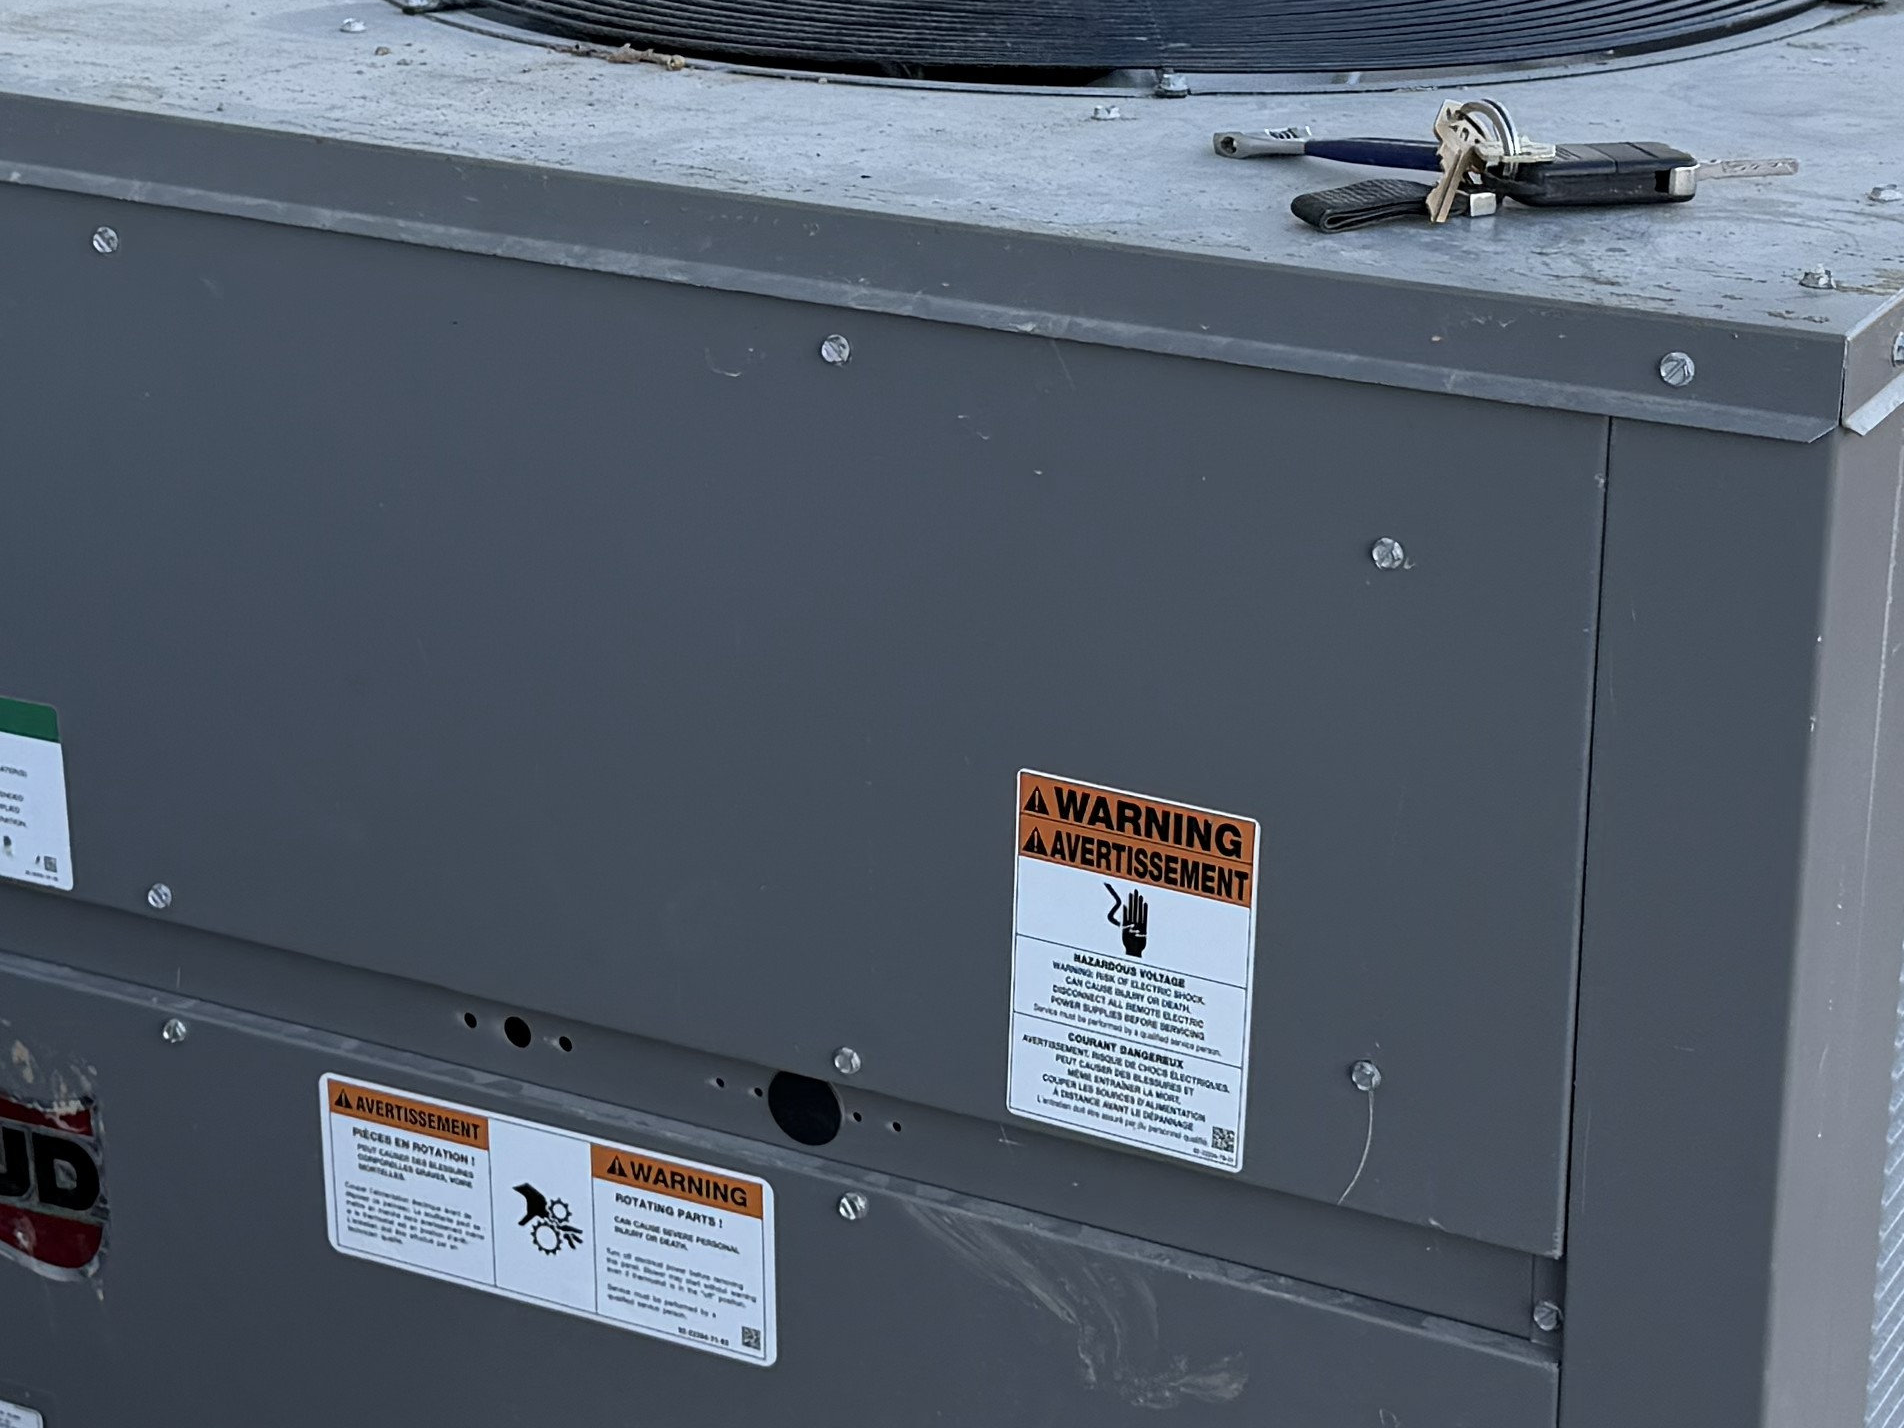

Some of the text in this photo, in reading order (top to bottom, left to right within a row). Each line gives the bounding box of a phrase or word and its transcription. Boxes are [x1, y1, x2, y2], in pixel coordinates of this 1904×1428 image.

[1053, 784, 1242, 859] WARNING
[1050, 829, 1248, 900] AVERTISSEMENT
[1073, 952, 1184, 988] HAZARDOUS VOLTAGE
[1096, 971, 1114, 983] RISK
[1117, 976, 1128, 987] OF
[1131, 980, 1171, 997] ELECTRIC
[1052, 984, 1203, 1029] DISCONNECT ALL REMOTE ELECTRIC
[1065, 975, 1082, 987] CAN
[1085, 980, 1112, 995] CAUSE
[1146, 995, 1159, 1006] OR
[1050, 995, 1080, 1010] POWER
[1082, 1003, 1122, 1020] SUPPLIES
[1124, 1013, 1157, 1029] BEFORE
[1068, 1031, 1183, 1069] COURANT DANGEREUX
[1091, 1051, 1122, 1066] RISQUE
[1124, 1059, 1136, 1069] DE
[1042, 1073, 1076, 1089] COUPER
[1078, 1082, 1093, 1093] LES
[1055, 1053, 1076, 1066] PEUT
[1079, 1059, 1112, 1075] CAUSER
[1114, 1068, 1130, 1080] DES
[1184, 1086, 1193, 1096] ET
[1061, 1089, 1099, 1106] DISTANCE
[1102, 1100, 1128, 1114] AVANT
[1131, 1107, 1140, 1117] LE
[1142, 1087, 1153, 1097] LA
[356, 1095, 480, 1140] AVERTISSEMENT
[394, 1137, 409, 1149] EN
[412, 1141, 467, 1164] ROTATION
[630, 1160, 747, 1207] WARNING
[615, 1192, 673, 1216] ROTATING
[678, 1207, 715, 1226] PARTS
